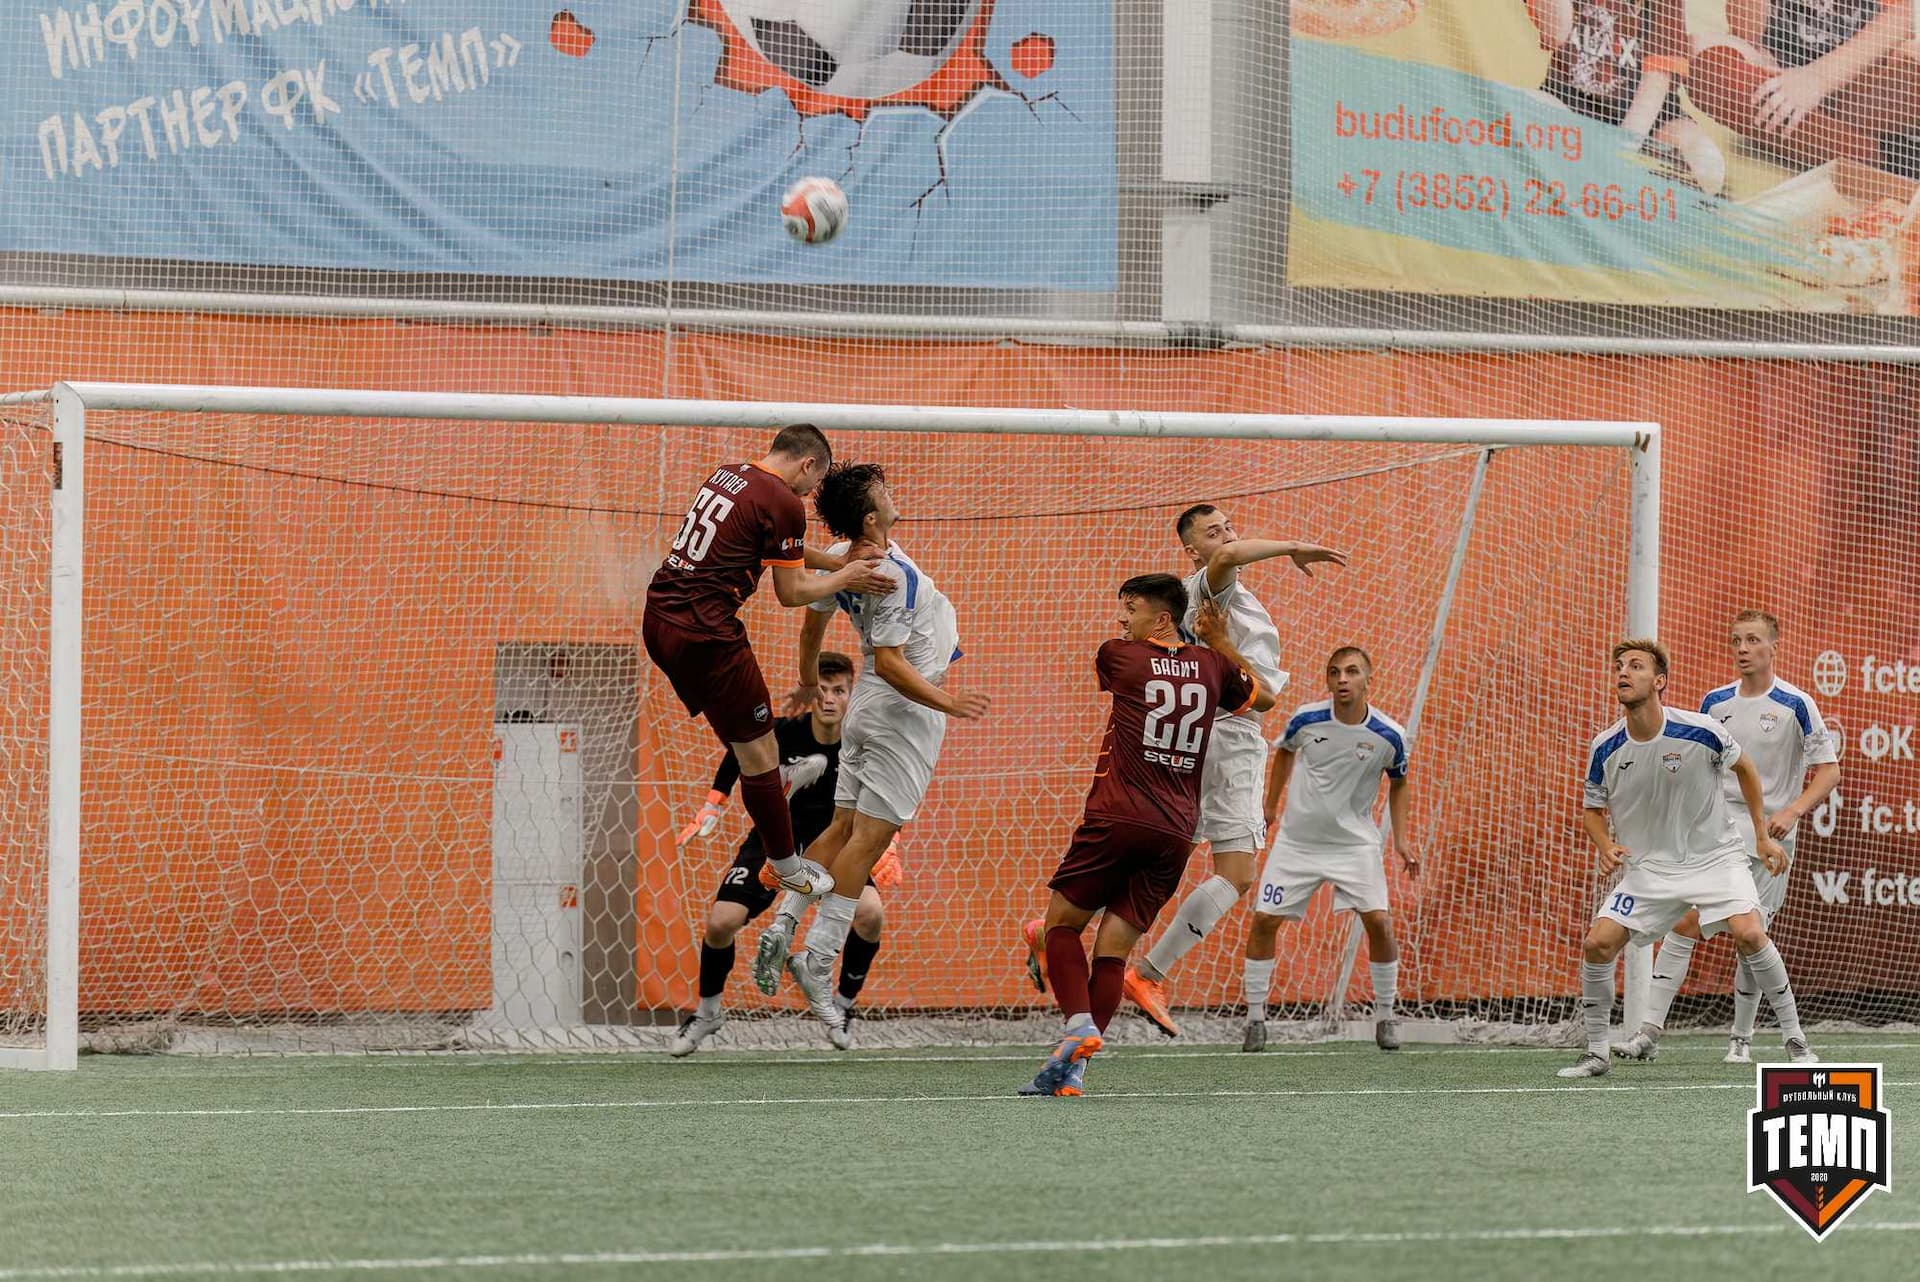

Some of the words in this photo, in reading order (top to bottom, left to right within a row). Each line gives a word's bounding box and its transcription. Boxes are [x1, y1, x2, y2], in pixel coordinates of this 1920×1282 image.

[38, 80, 248, 180] ПАРТНЕР
[261, 58, 341, 130] ФК
[354, 26, 521, 109] «ТЕМП»
[1336, 100, 1583, 162] budufood.org
[1336, 168, 1382, 205] +7
[1395, 170, 1510, 220] (3852)
[1523, 178, 1677, 222] 22-66-01
[1150, 658, 1200, 679] БАБИЧ
[1142, 680, 1208, 754] 22
[1143, 749, 1196, 770] SEUS
[1859, 720, 1915, 762] ФК
[1858, 794, 1920, 834] fc.t
[725, 866, 749, 886] 72
[1263, 883, 1285, 906] 96
[1610, 892, 1635, 916] 19
